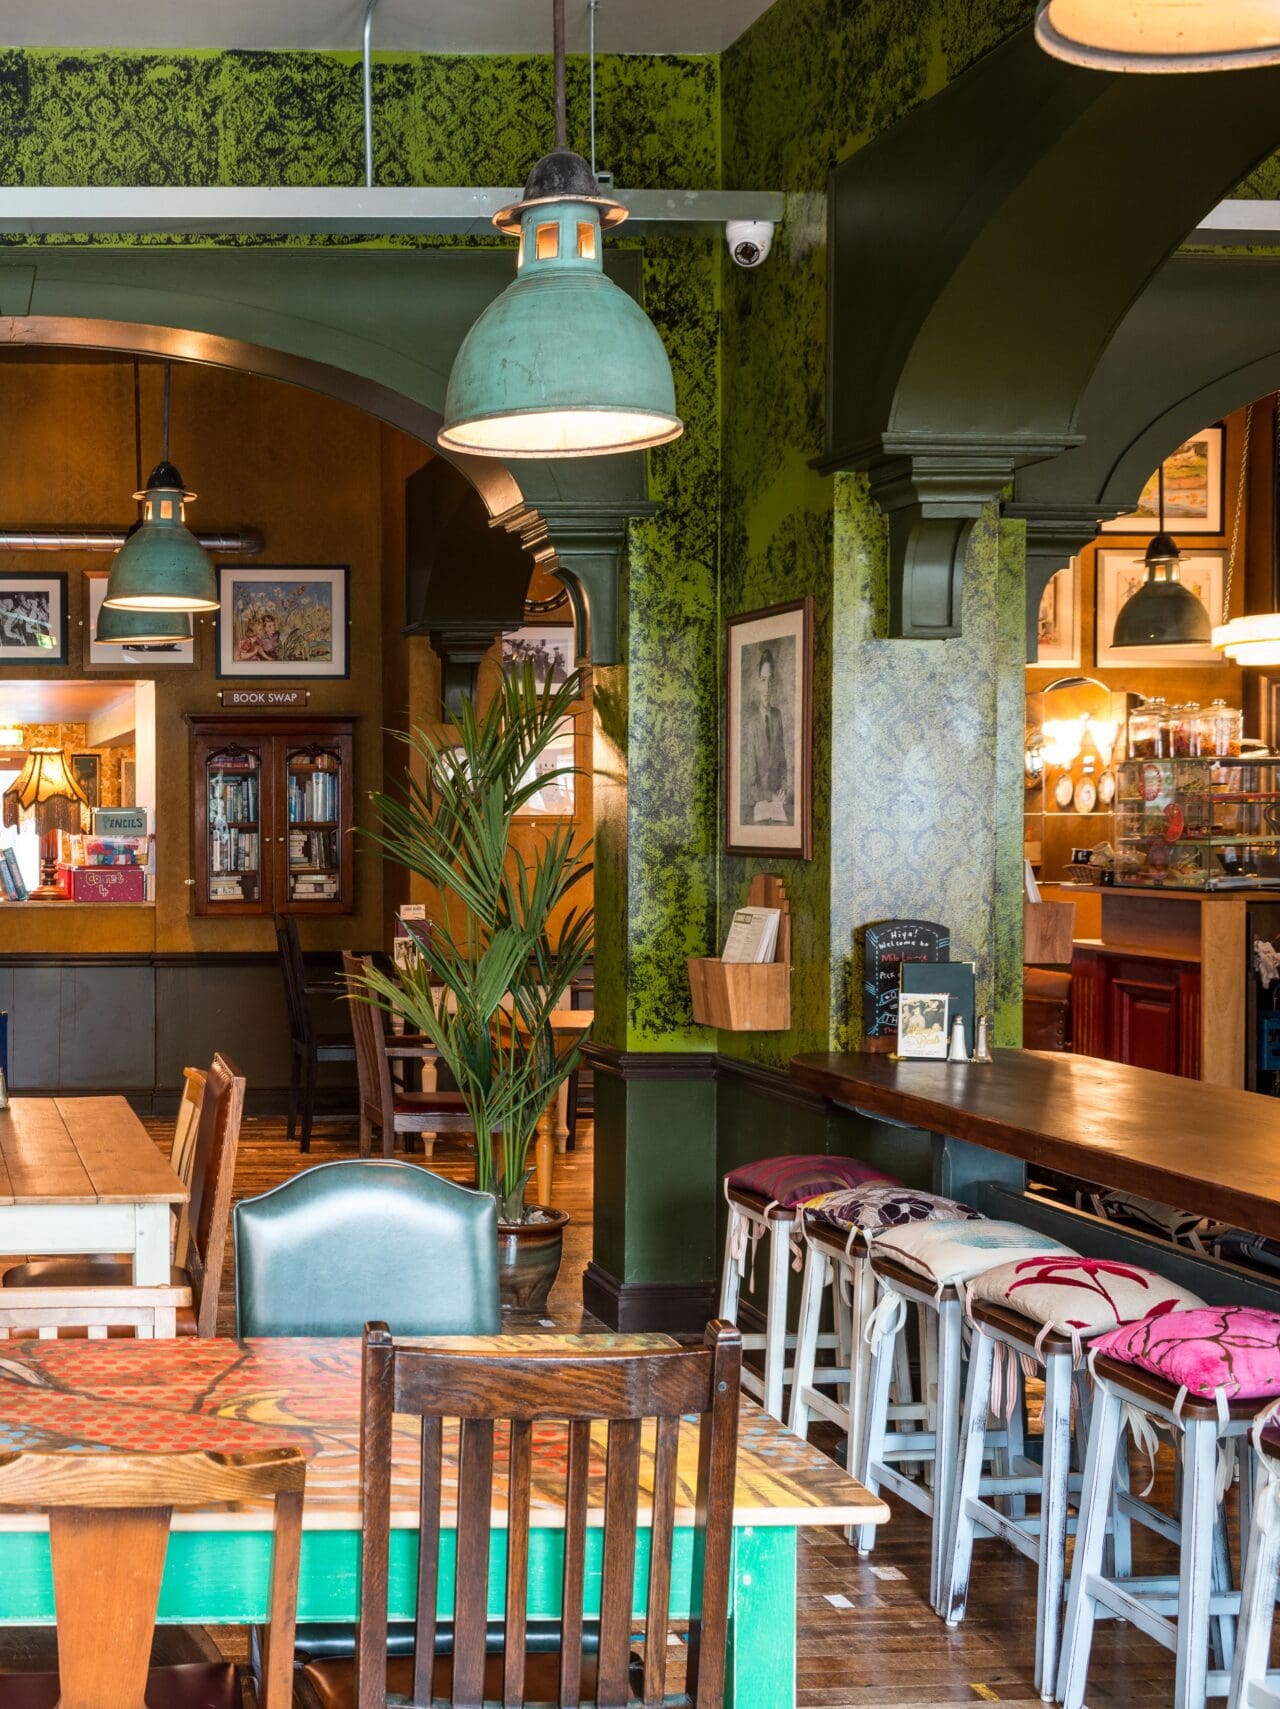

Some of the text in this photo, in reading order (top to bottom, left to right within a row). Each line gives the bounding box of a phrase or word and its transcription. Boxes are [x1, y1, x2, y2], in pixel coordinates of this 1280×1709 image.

[233, 693, 297, 703] BOOK SWAP
[102, 815, 143, 830] PENCILS
[891, 929, 918, 940] Hiya!
[879, 941, 916, 949] Welcome
